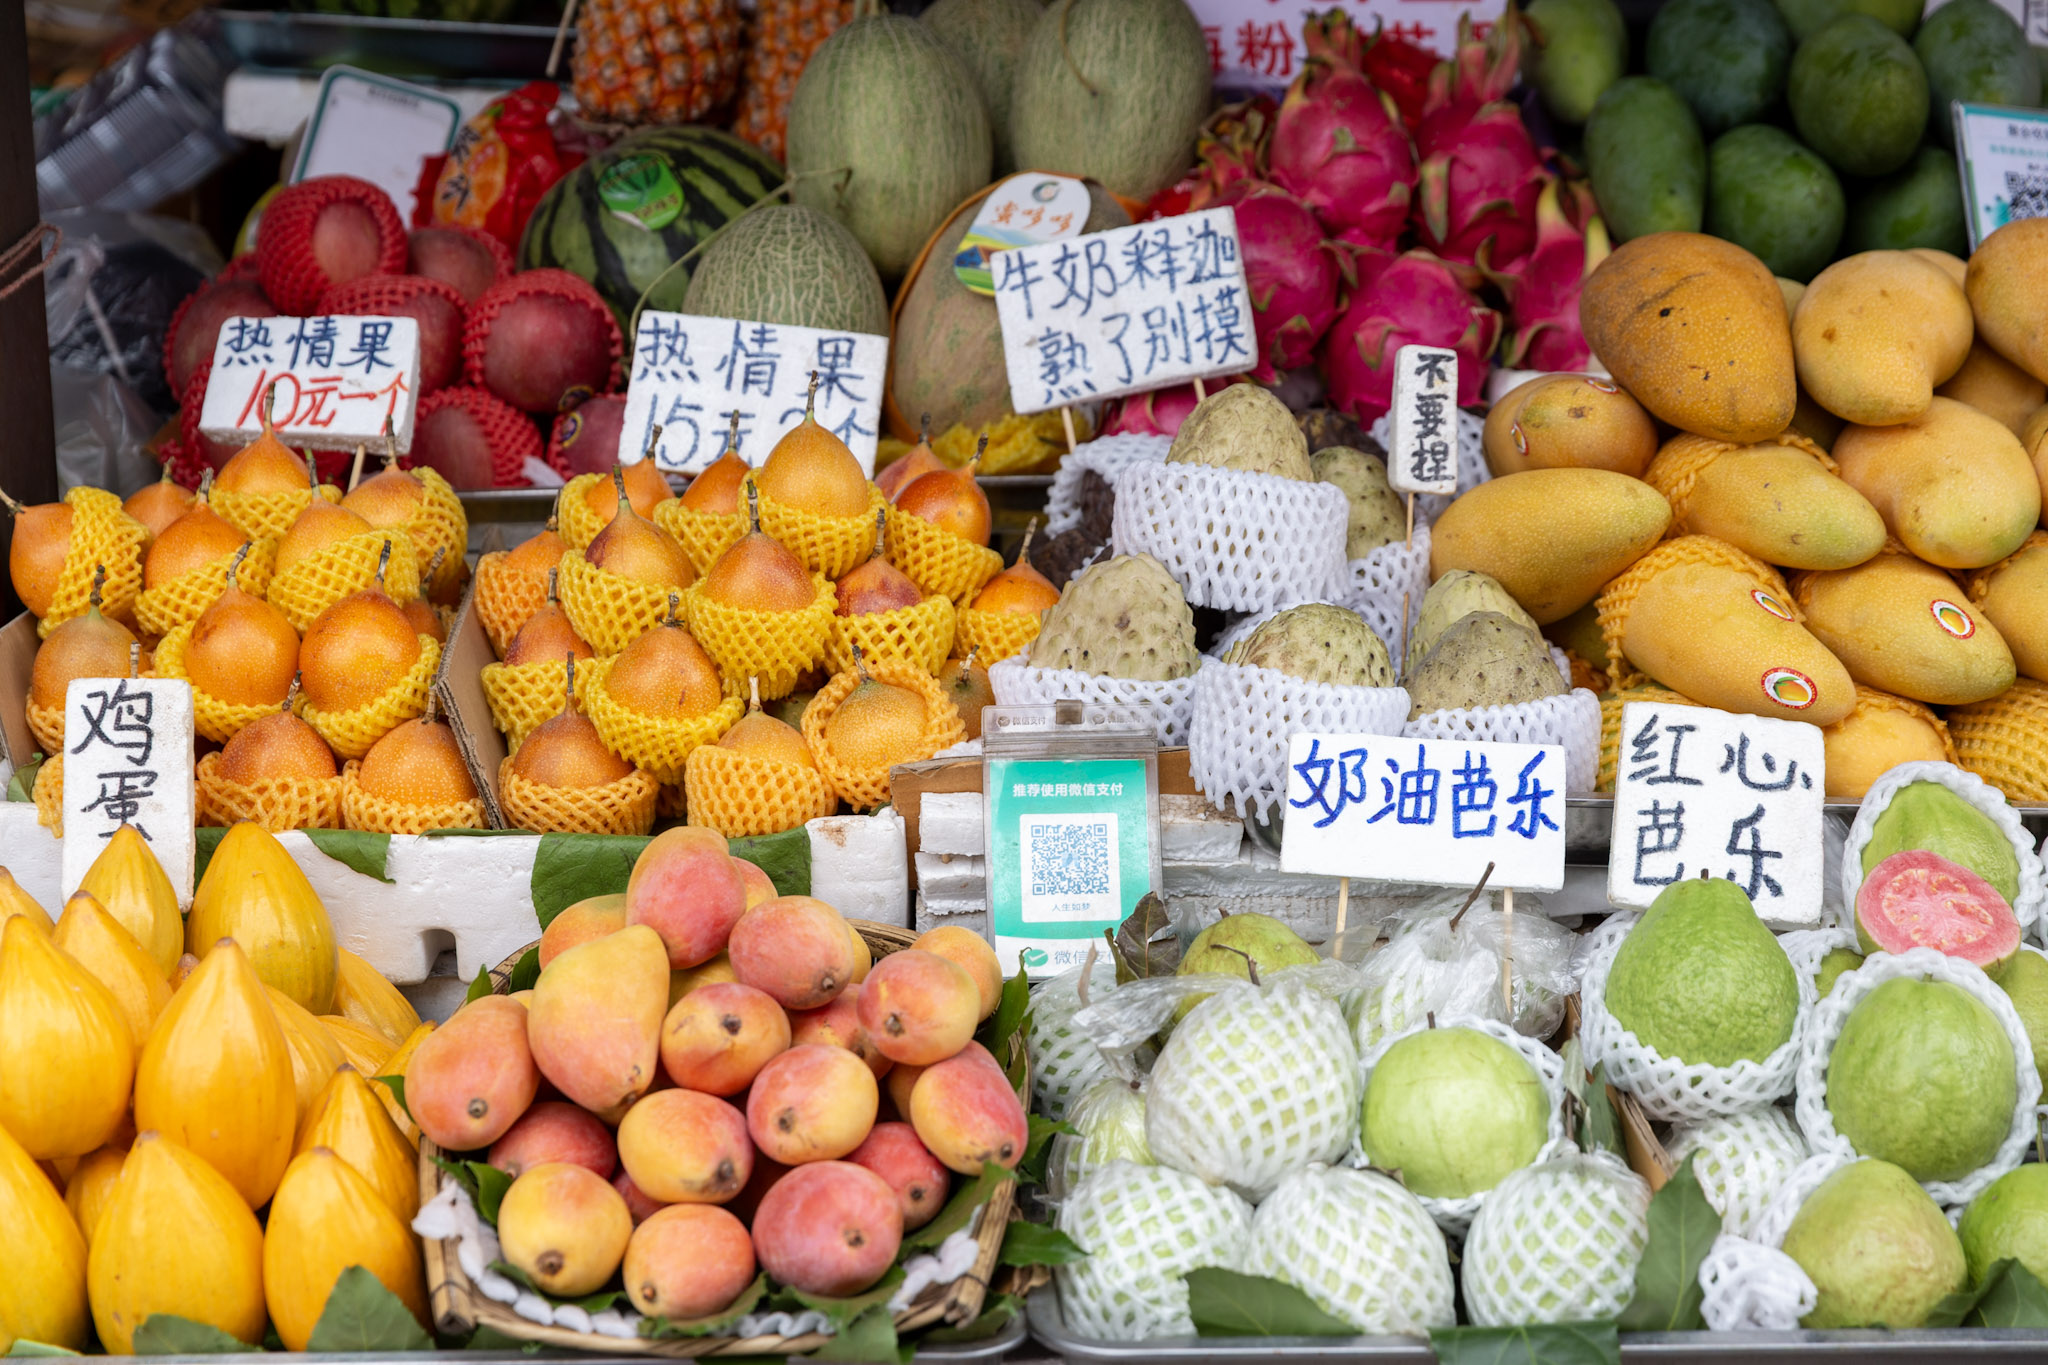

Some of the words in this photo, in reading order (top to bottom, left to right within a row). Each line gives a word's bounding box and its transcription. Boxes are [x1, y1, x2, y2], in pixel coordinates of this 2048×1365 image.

[996, 218, 1239, 320] 牛奶释迦
[221, 316, 396, 374] 热情果
[636, 316, 867, 409] 热情果
[1037, 284, 1249, 405] 熟了别摸
[235, 368, 410, 436] 10元一个
[1410, 352, 1456, 482] 不要捏
[71, 678, 158, 842] 鸡蛋
[1012, 715, 1046, 726] 微信支付
[1627, 713, 1813, 792] 红心
[1012, 782, 1124, 798] 推荐使用微信支付
[1289, 738, 1560, 840] 奶油芭乐
[1633, 798, 1784, 902] 芭乐
[1051, 902, 1091, 912] 人生如梦
